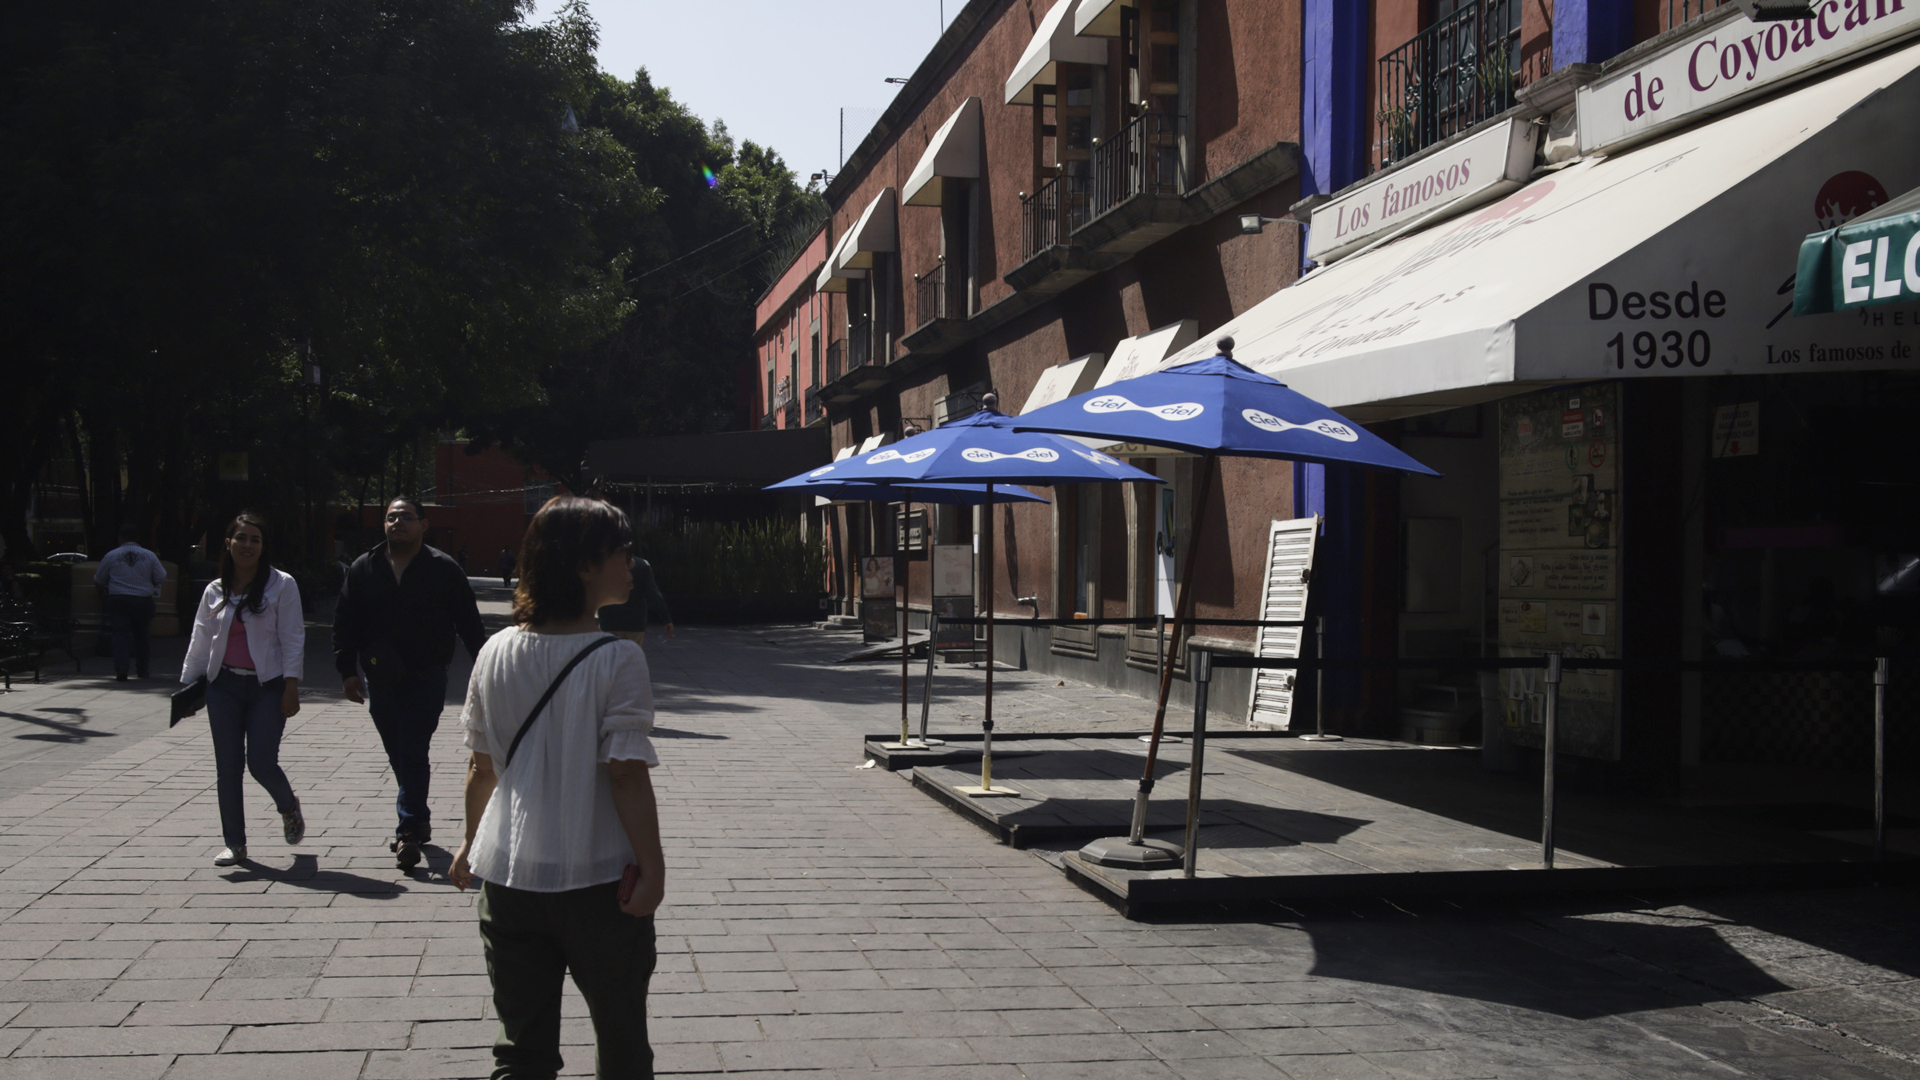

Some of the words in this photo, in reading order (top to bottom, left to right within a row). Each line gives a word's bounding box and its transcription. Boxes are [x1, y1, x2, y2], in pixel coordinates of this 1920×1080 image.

[1624, 72, 1665, 121] de
[1334, 203, 1371, 239] Los
[1380, 158, 1471, 221] famosos
[1588, 280, 1727, 321] Desde
[1606, 329, 1711, 370] 1930
[1766, 344, 1801, 364] Los
[1809, 342, 1884, 362] famosos
[1891, 340, 1911, 359] de
[1091, 398, 1127, 410] ciel
[1161, 405, 1198, 416] ciel
[1249, 413, 1282, 427] ciel
[1318, 423, 1351, 436] ciel
